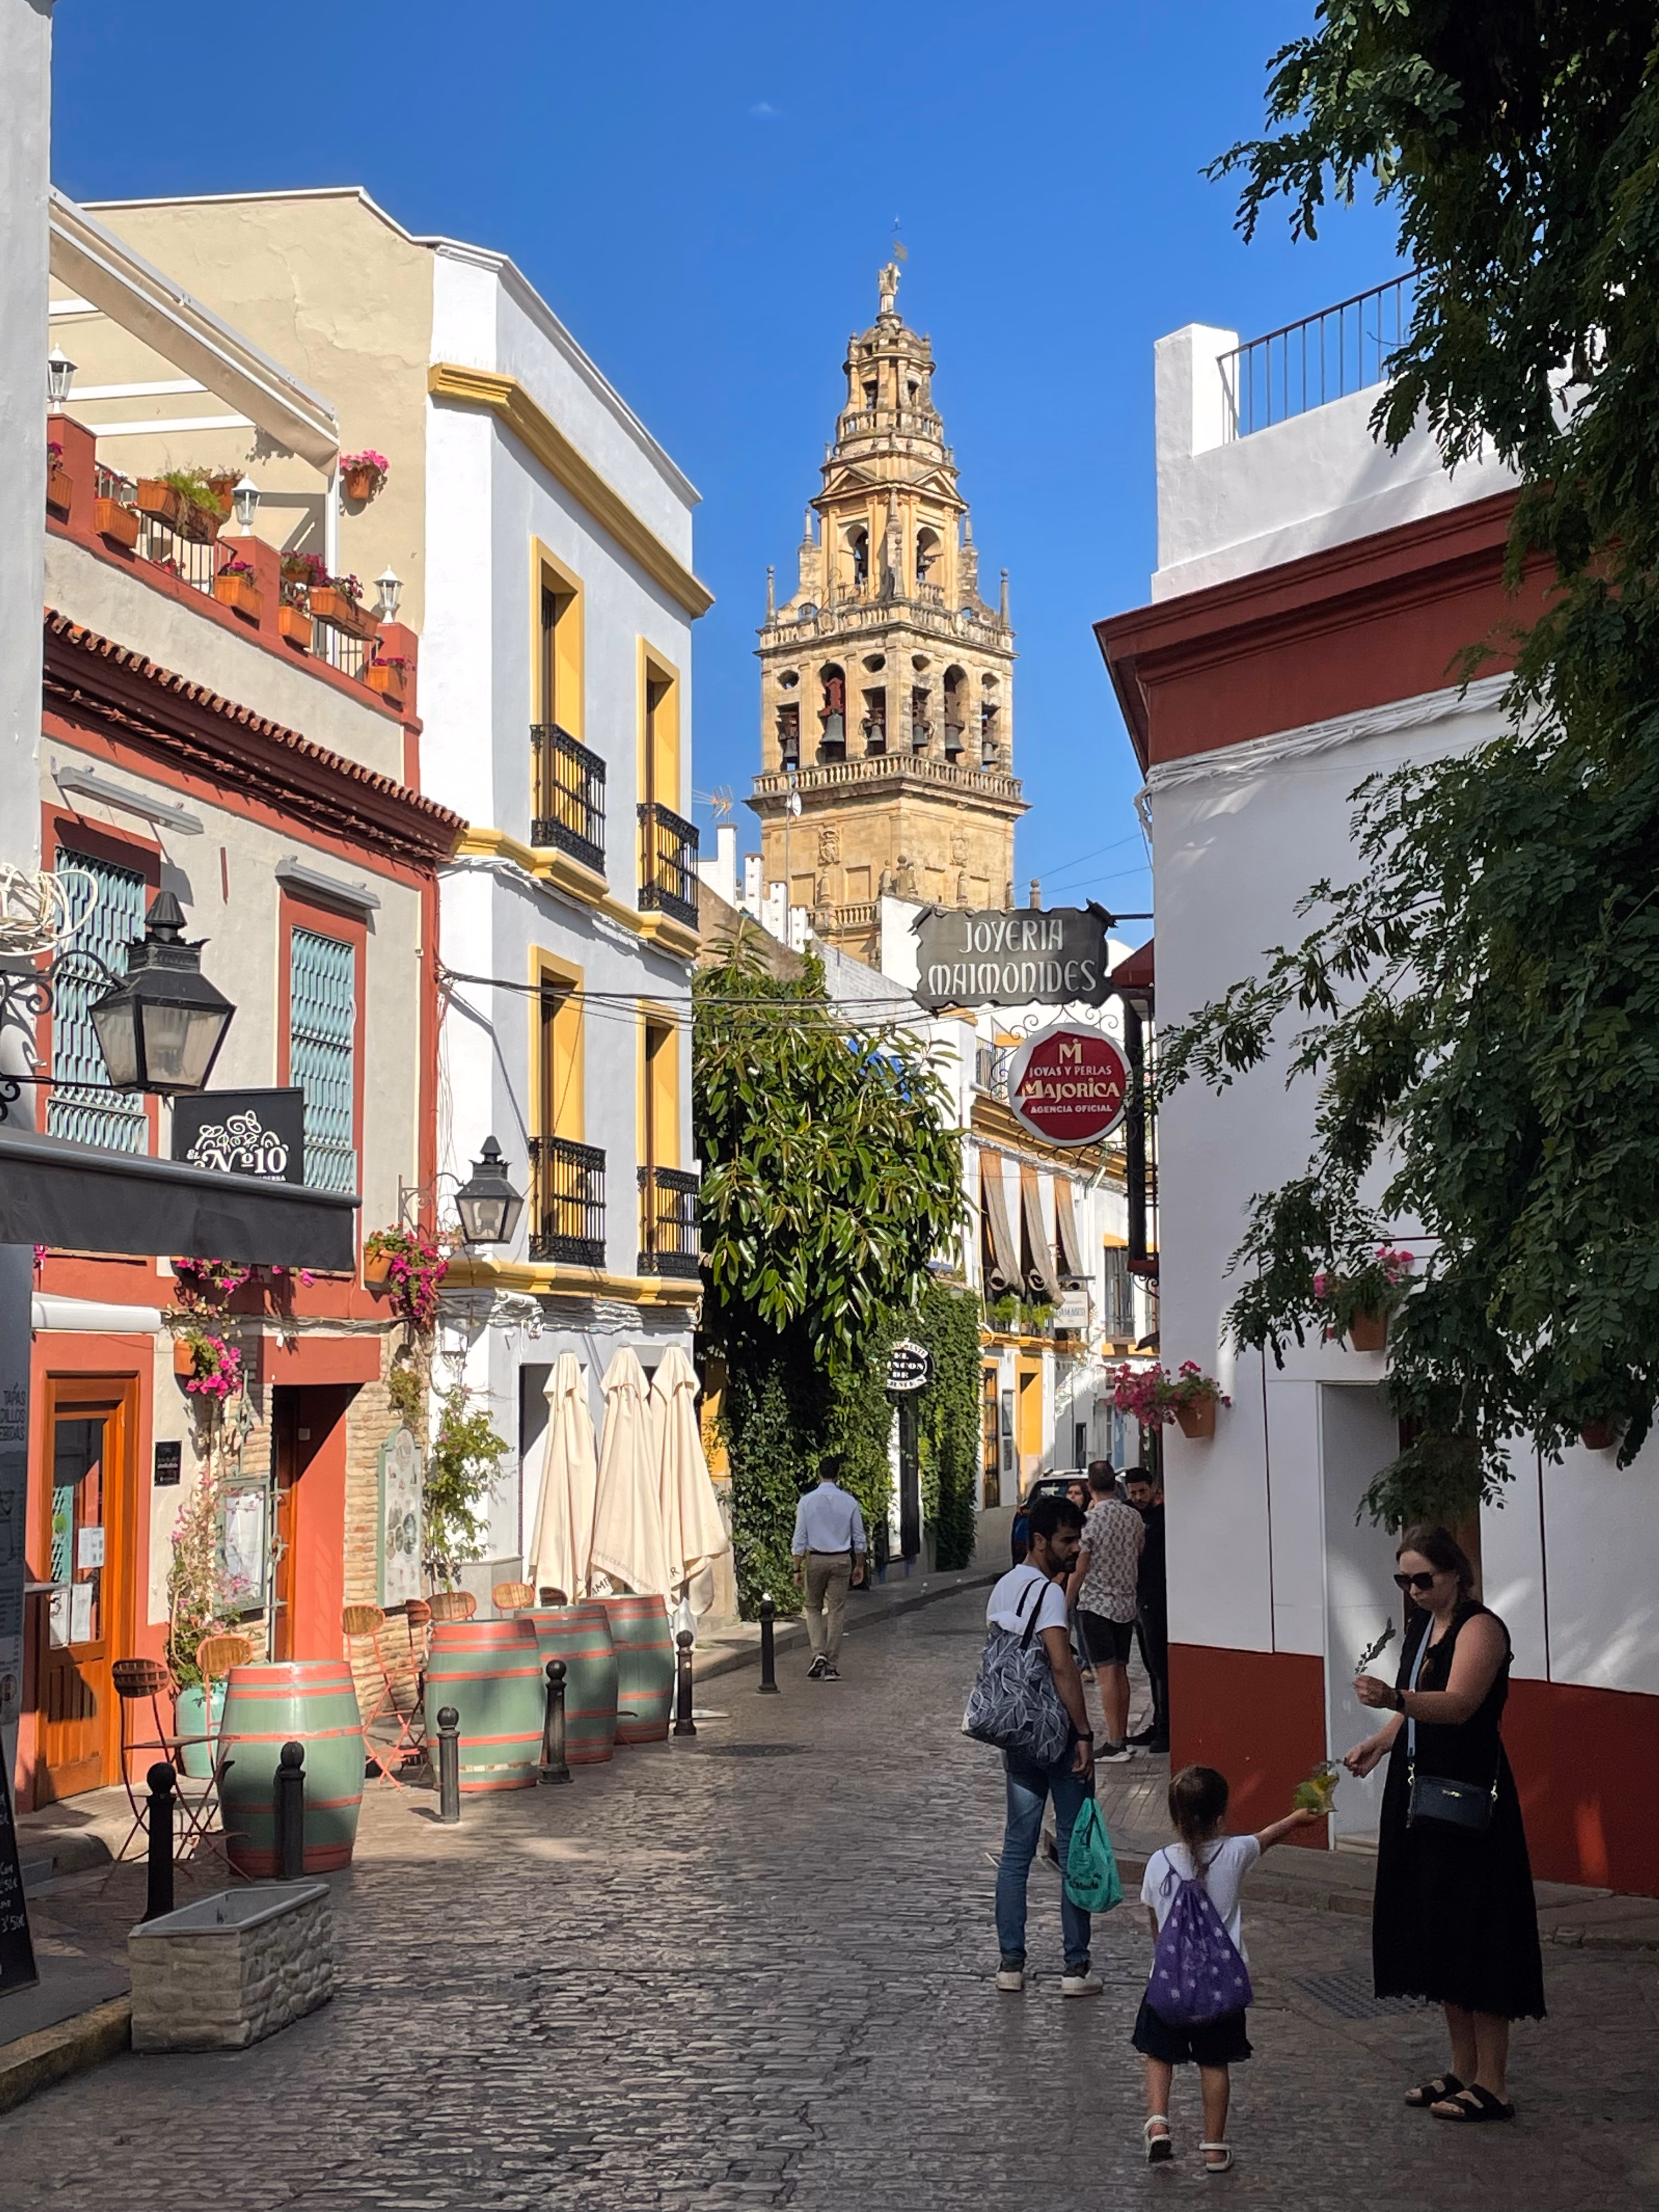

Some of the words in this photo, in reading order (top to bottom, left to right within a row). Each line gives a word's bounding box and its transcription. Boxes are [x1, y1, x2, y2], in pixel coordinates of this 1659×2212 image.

[958, 919, 1063, 953] JOYERIA
[928, 960, 1096, 995] MAIMONIDES
[1029, 1066, 1062, 1078] JOYAS
[1064, 1066, 1071, 1076] Y
[1074, 1065, 1112, 1075] PERLAS
[1031, 1105, 1072, 1114] AGENCIA
